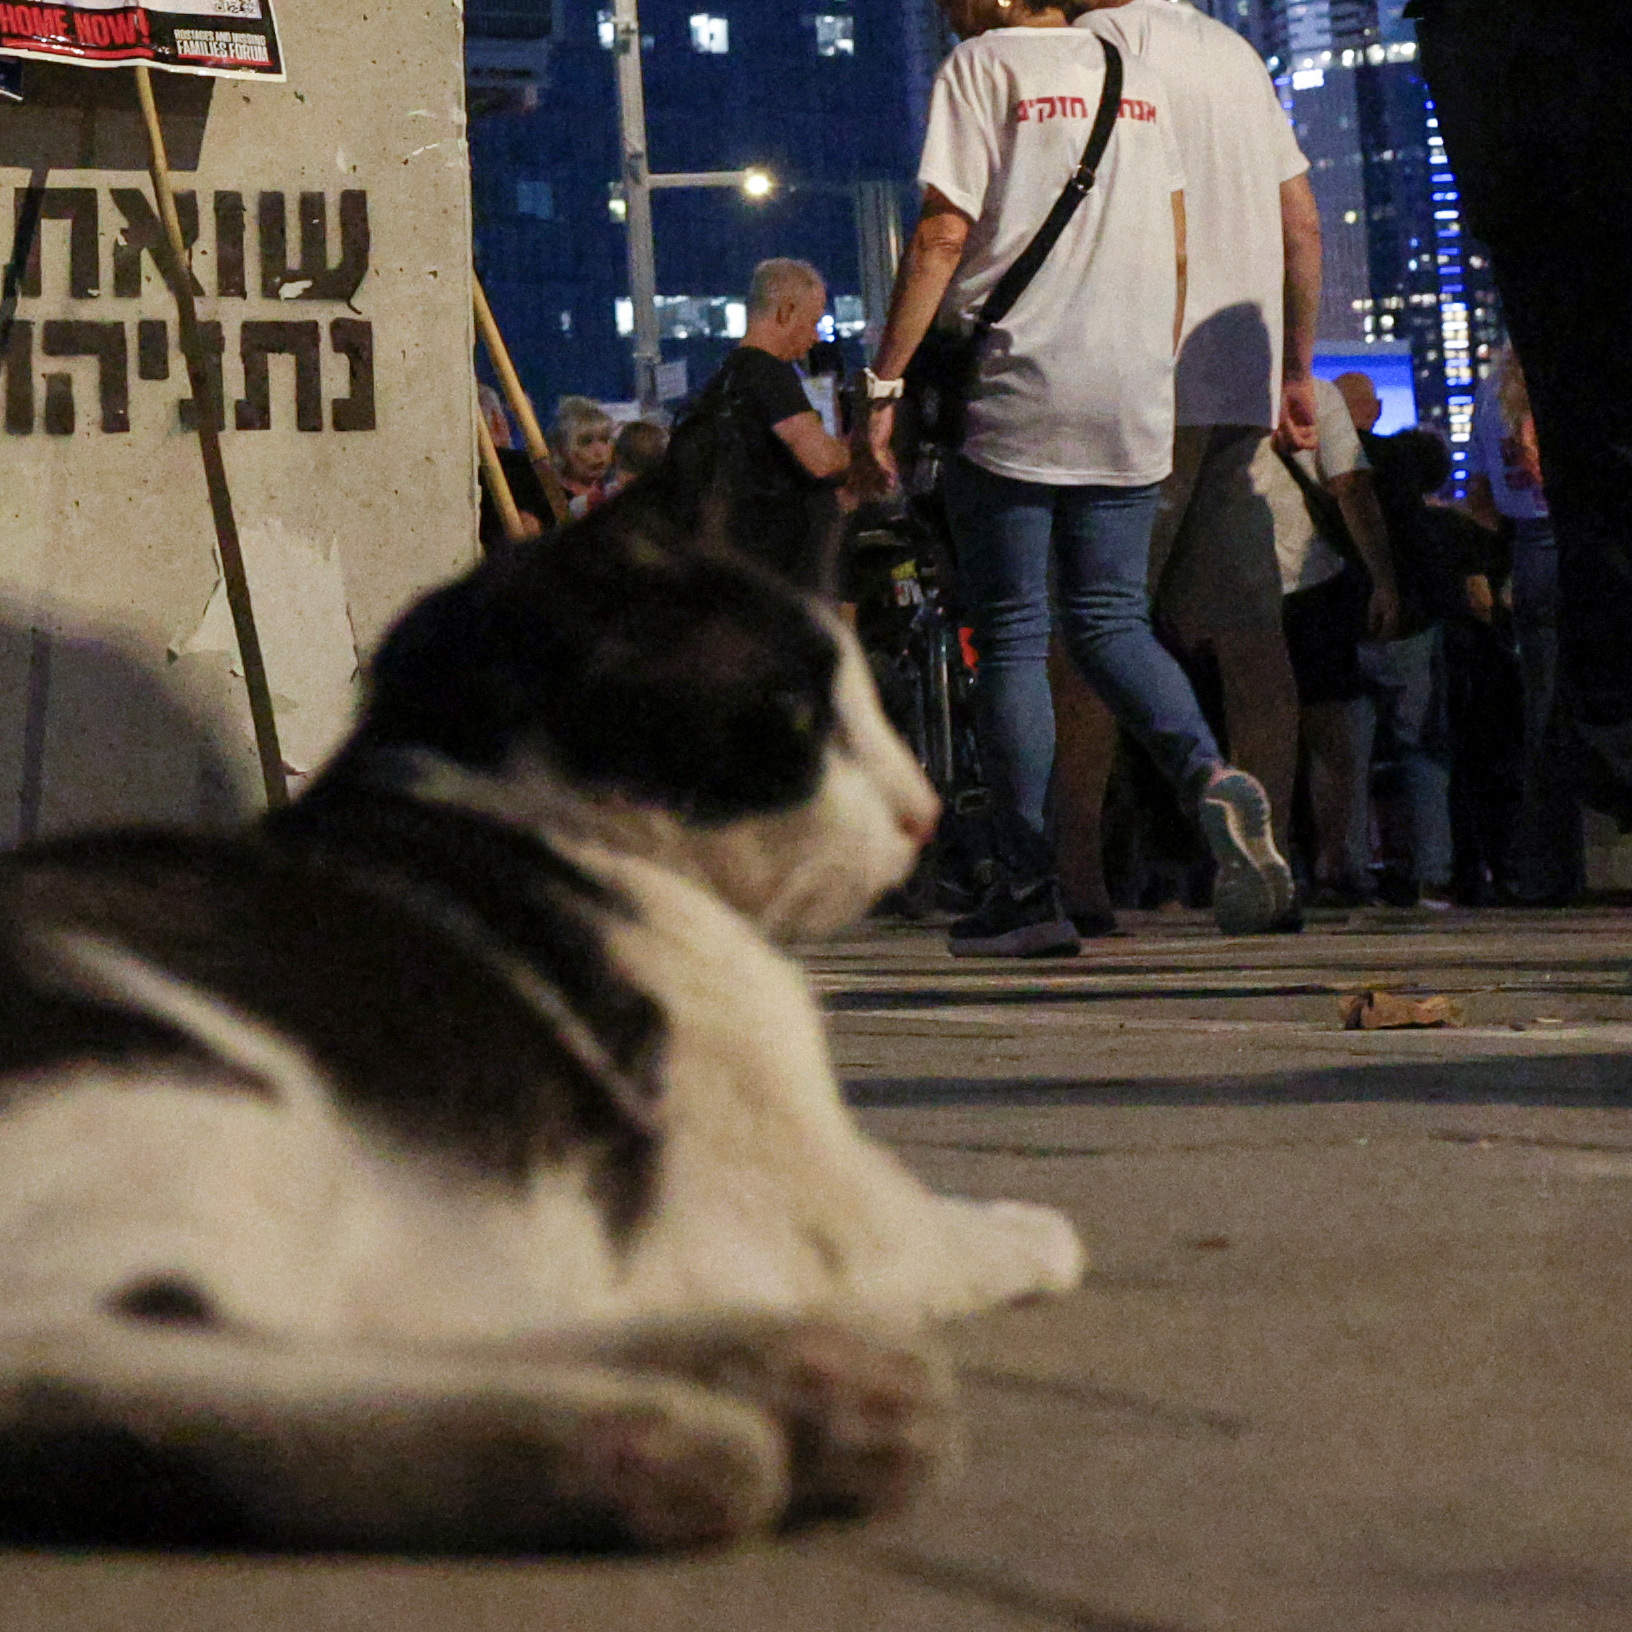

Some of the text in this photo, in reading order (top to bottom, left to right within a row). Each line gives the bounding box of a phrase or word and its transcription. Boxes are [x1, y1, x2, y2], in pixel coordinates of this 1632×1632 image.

[73, 8, 151, 46] NOW!
[176, 39, 269, 62] FAMILIES FORUM
[3, 186, 370, 300] שואת
[5, 316, 376, 435] נתניהו
